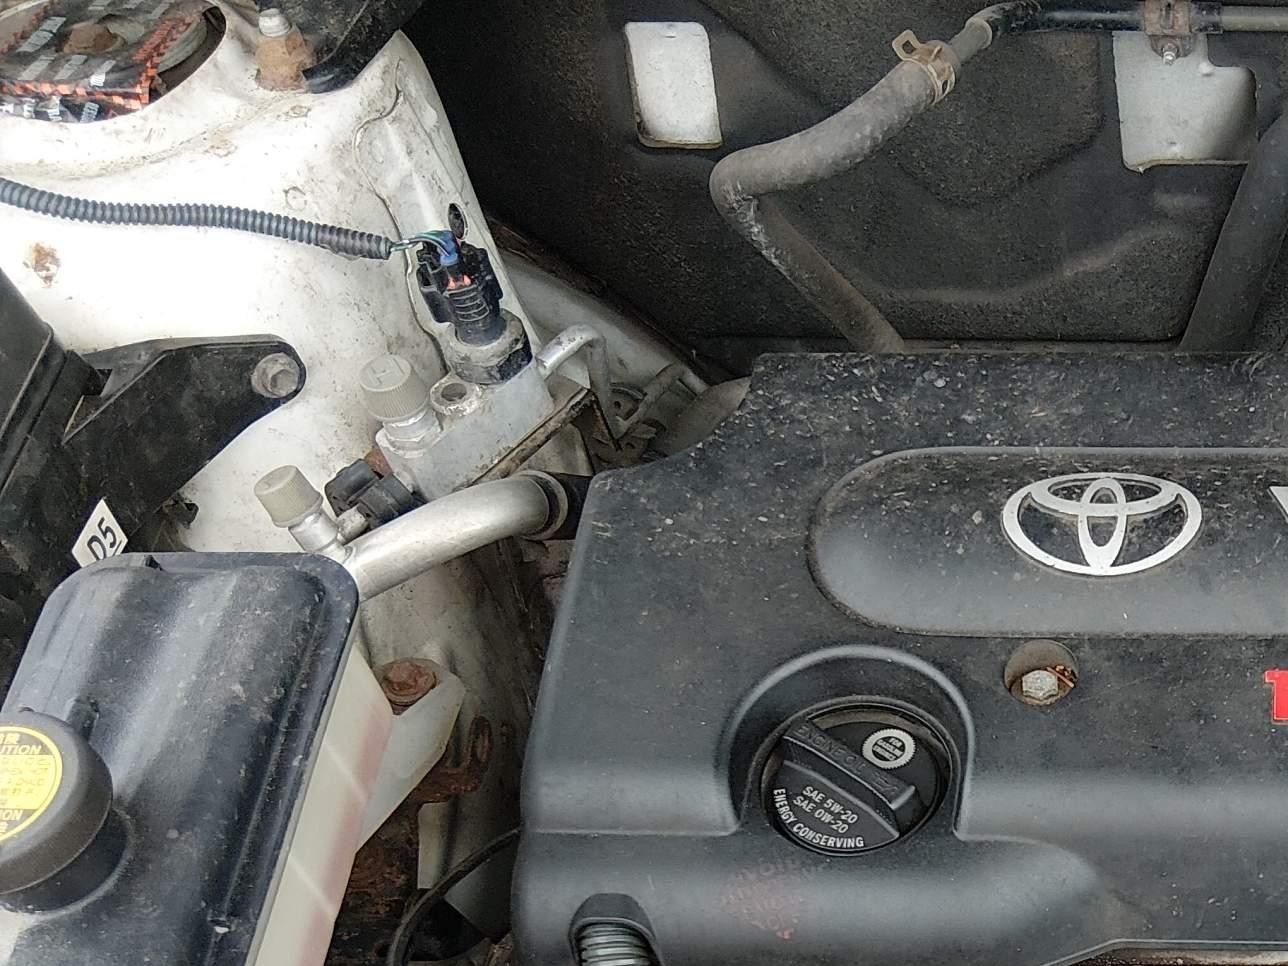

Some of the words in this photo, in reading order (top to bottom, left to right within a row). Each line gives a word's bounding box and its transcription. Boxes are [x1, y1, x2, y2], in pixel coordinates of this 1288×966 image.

[773, 788, 798, 824] ENERGY
[792, 823, 865, 849] CONSERVING
[792, 795, 817, 813] SAE
[814, 808, 849, 834] 0W-20
[802, 786, 826, 803] SAE
[823, 798, 858, 824] 5W-20
